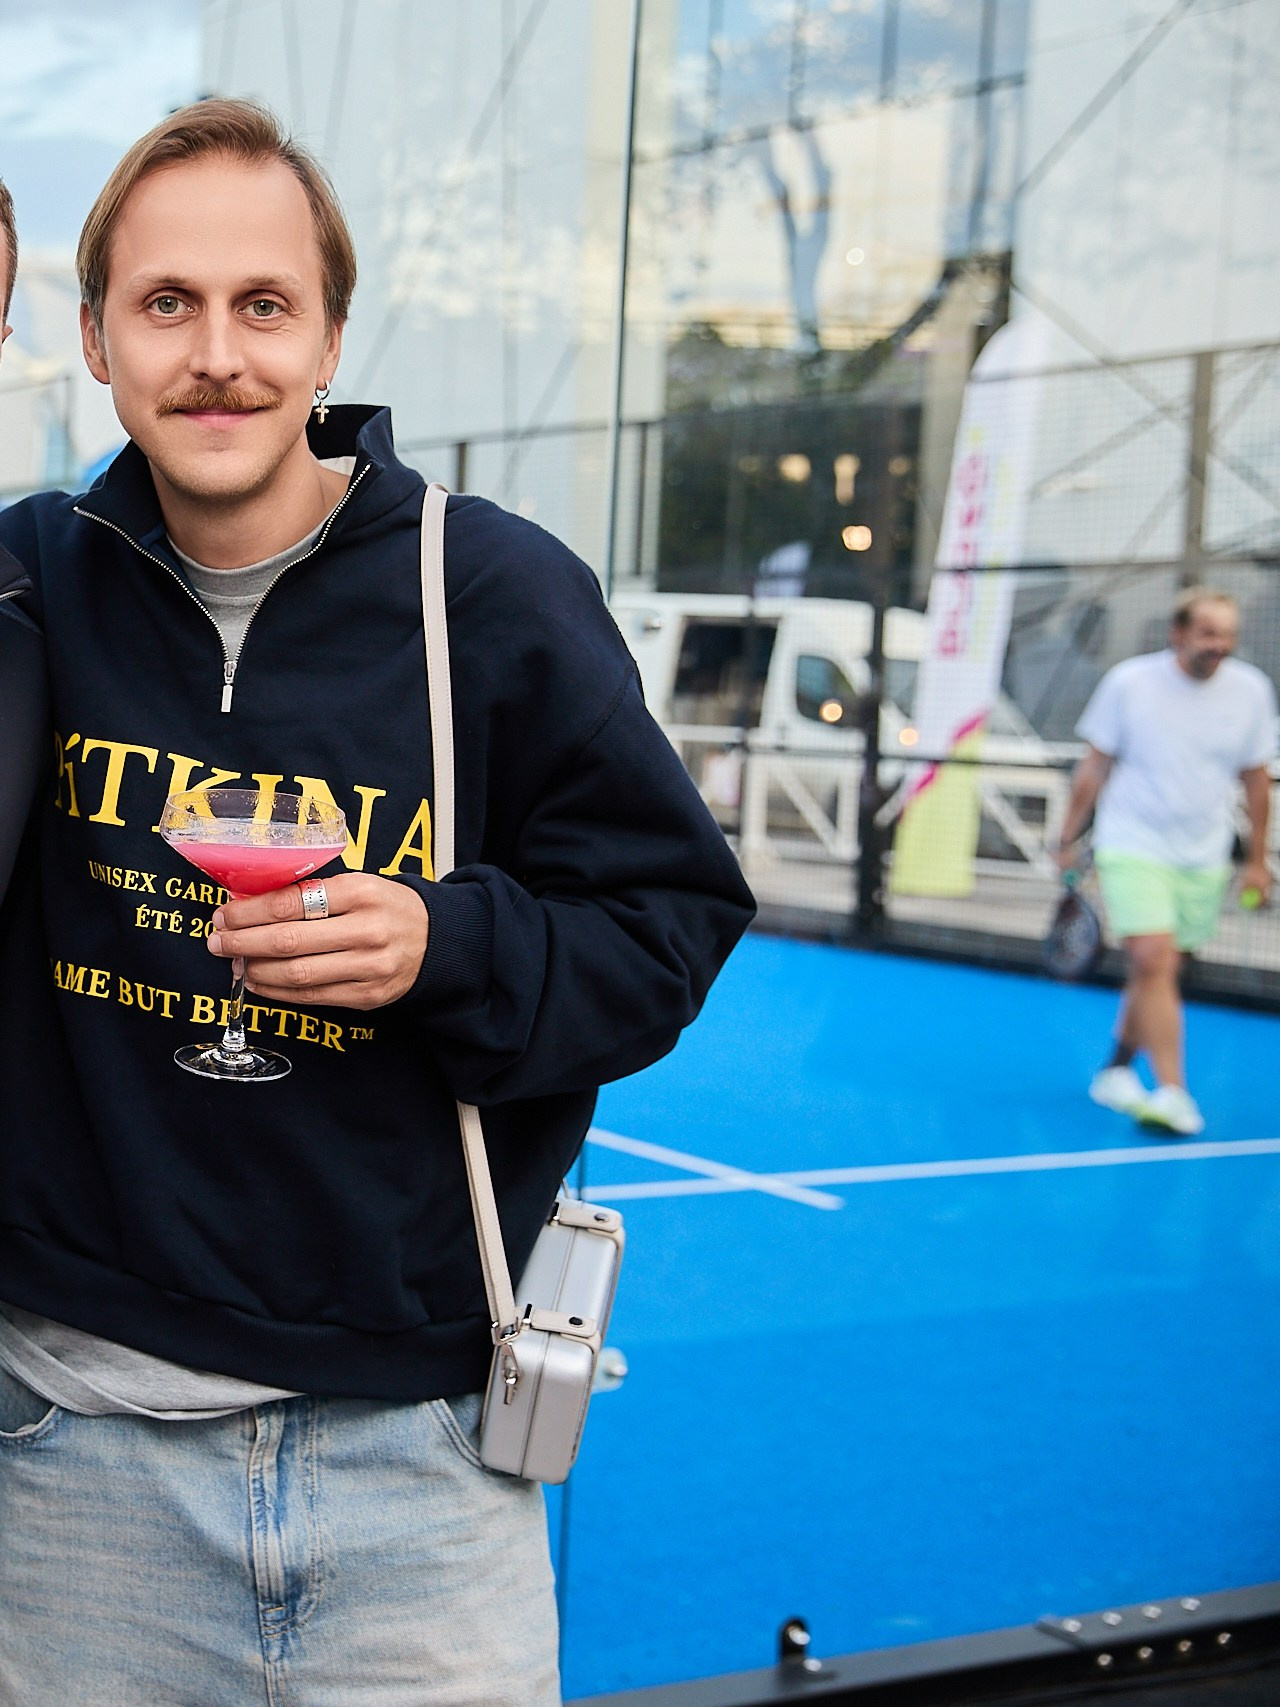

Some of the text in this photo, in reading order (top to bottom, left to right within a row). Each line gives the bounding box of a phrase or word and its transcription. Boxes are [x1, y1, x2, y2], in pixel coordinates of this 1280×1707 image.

[88, 860, 158, 894] UNISEX
[135, 903, 183, 934] ÉTÉ
[49, 957, 111, 999] AME
[118, 976, 181, 1019] BUT
